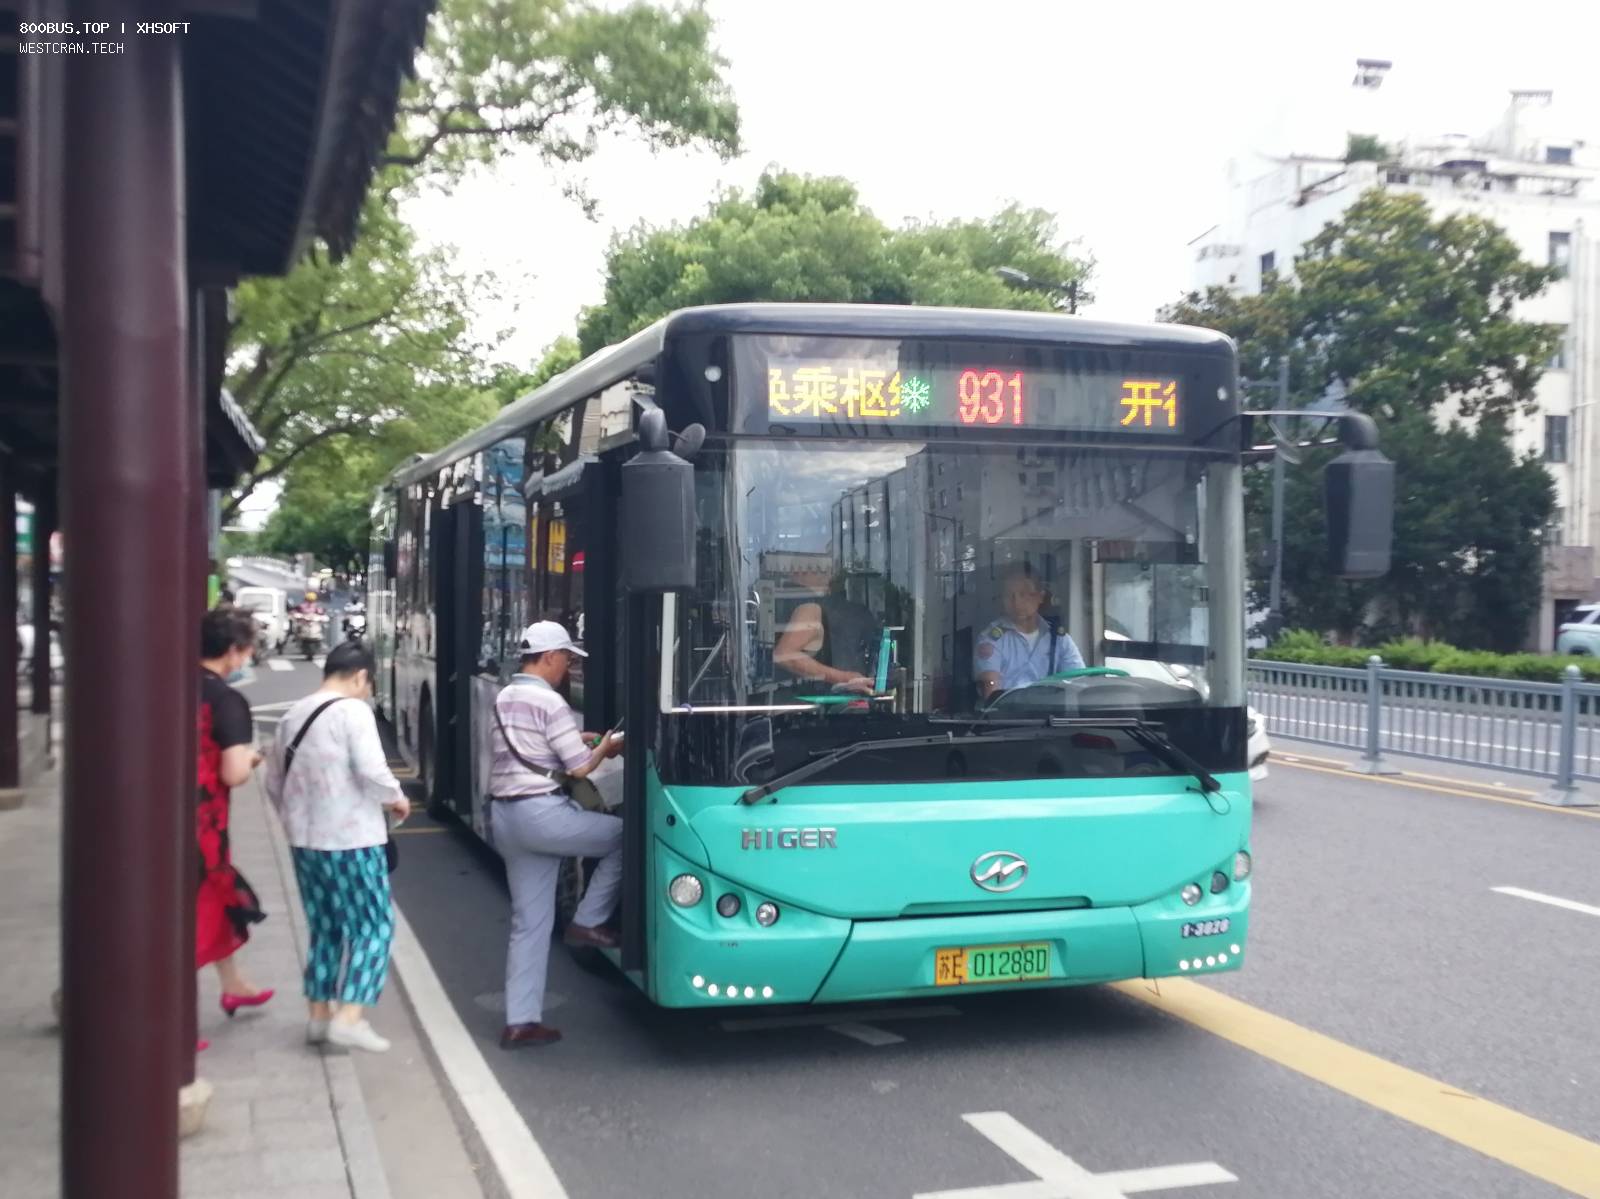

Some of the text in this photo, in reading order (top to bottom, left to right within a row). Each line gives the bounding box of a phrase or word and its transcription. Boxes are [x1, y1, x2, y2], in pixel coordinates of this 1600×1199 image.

[768, 366, 901, 418] 乘枢
[958, 367, 1024, 426] 931
[741, 827, 838, 850] HIGER
[973, 948, 1048, 977] 01288D
